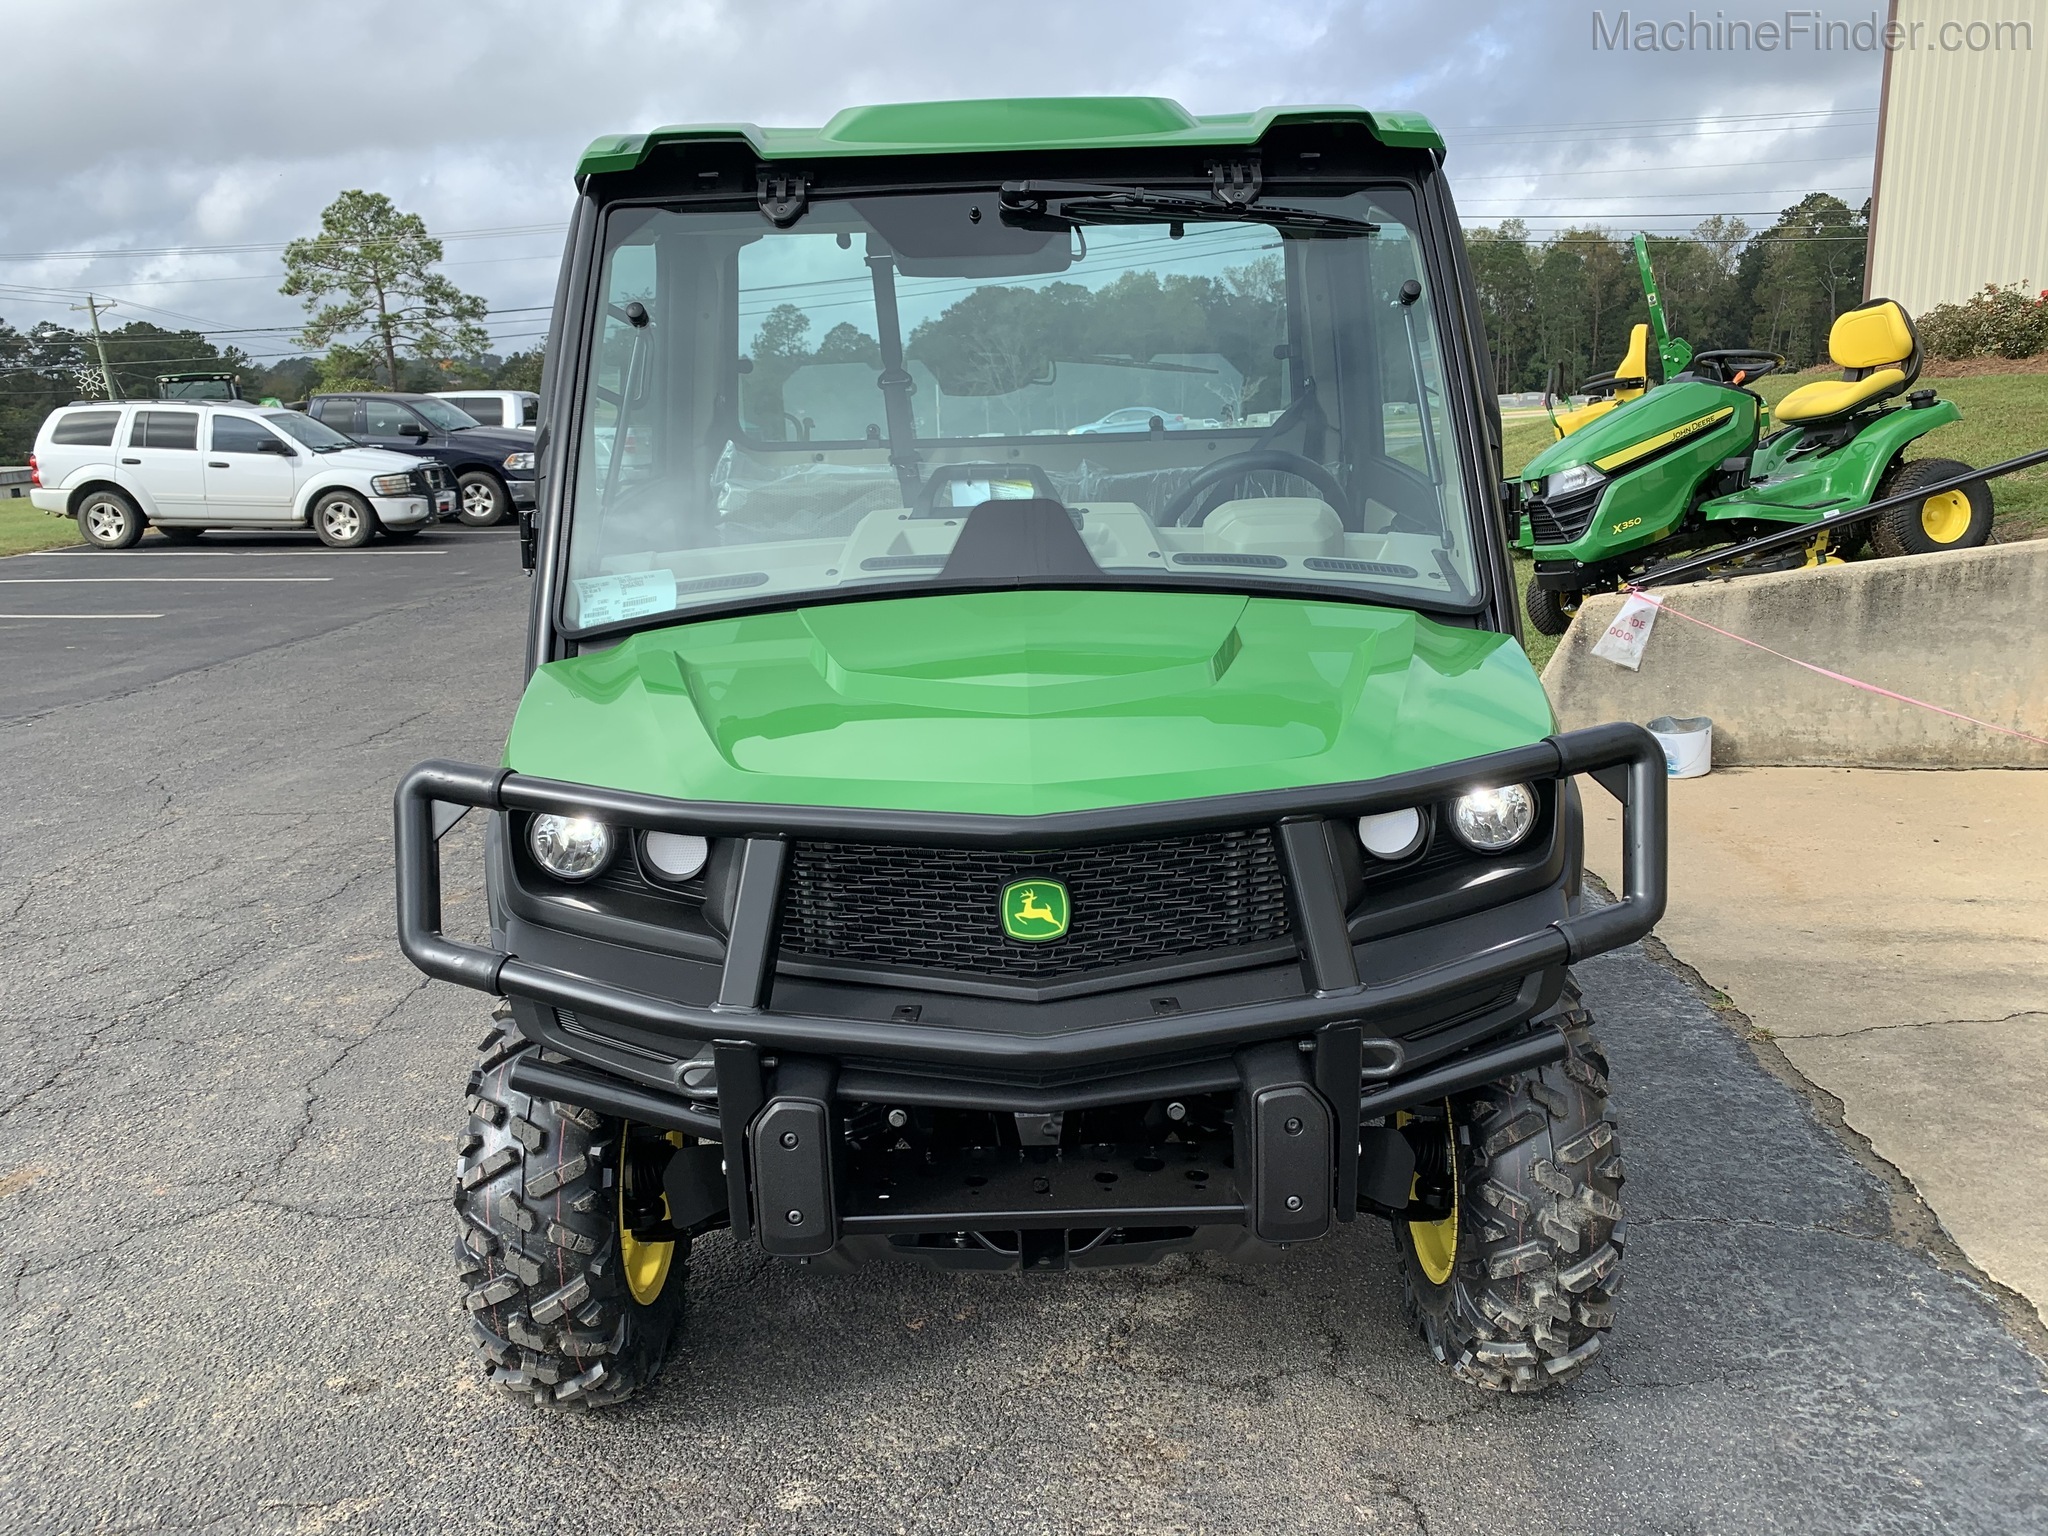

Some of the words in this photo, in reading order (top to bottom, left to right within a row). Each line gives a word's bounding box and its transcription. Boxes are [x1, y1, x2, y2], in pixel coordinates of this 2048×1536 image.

[1671, 427, 1692, 441] JOHN
[1691, 415, 1716, 431] DEERE
[1612, 517, 1642, 535] X350
